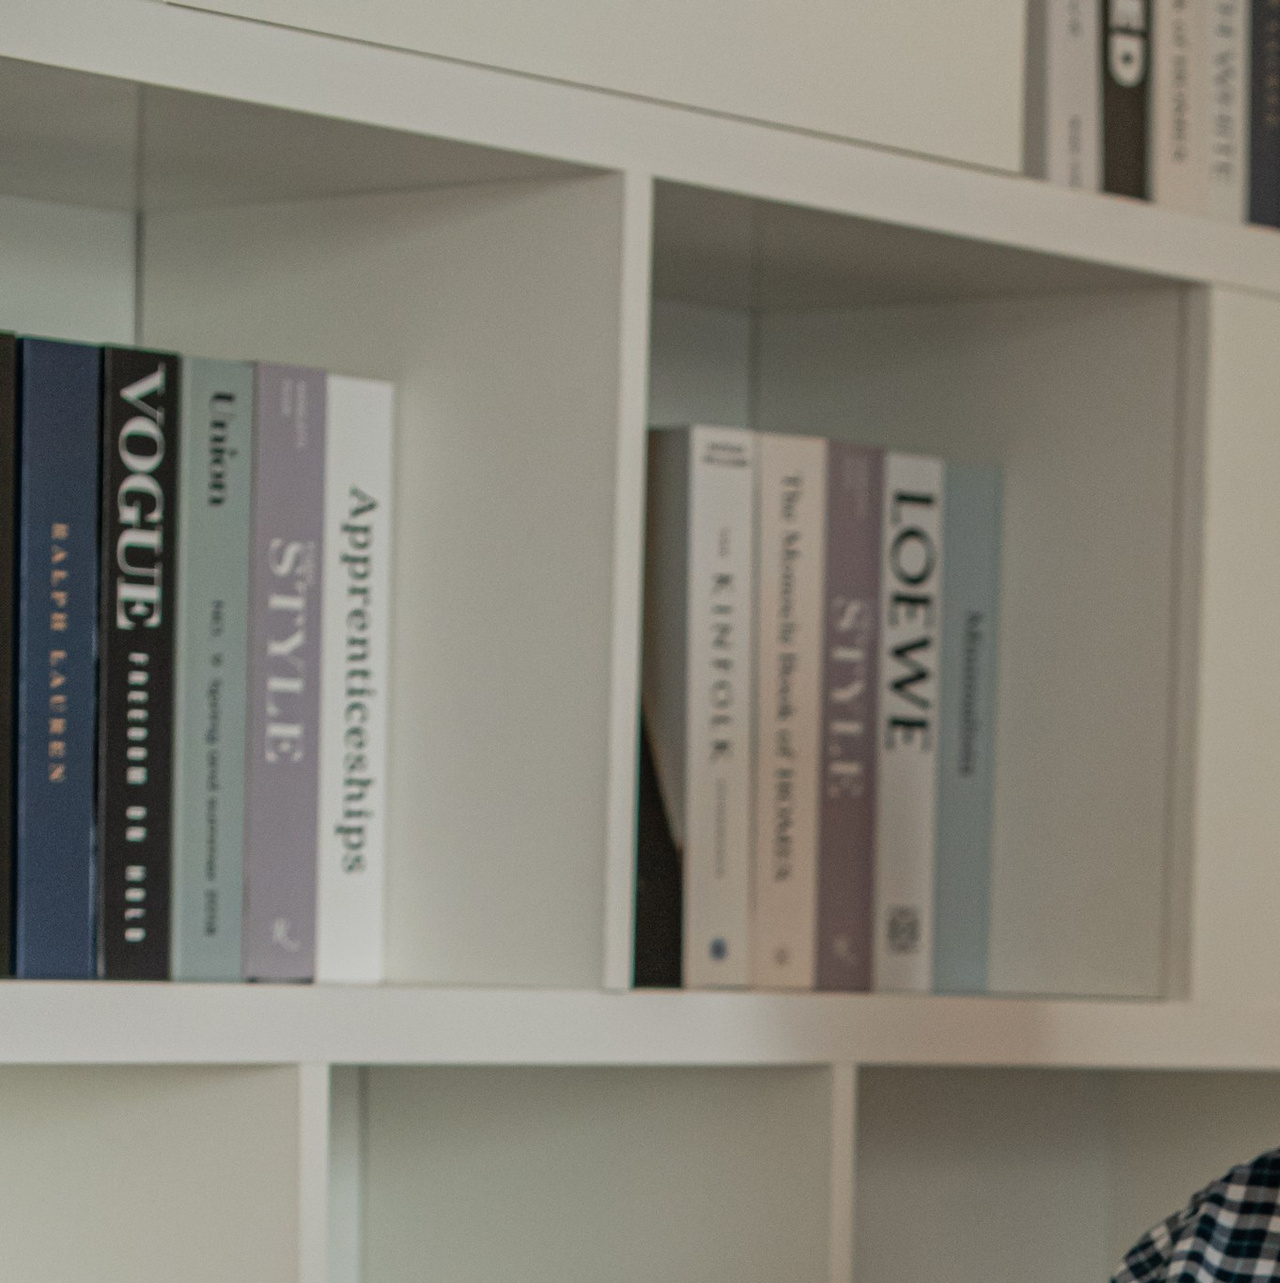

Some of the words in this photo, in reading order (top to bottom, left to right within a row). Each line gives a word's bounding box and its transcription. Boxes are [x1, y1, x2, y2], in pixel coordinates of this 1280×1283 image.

[116, 363, 166, 630] VOGUE
[207, 392, 236, 507] Union
[49, 523, 70, 631] RALPH
[265, 537, 306, 764] STYLE
[709, 572, 735, 762] KINFOLK
[886, 490, 935, 752] LOEWE
[48, 650, 68, 783] LAUREN
[126, 652, 150, 785] FREEDOM
[335, 486, 378, 875] Apprenticeships
[829, 598, 868, 799] STYLE
[124, 866, 146, 942] HOLD
